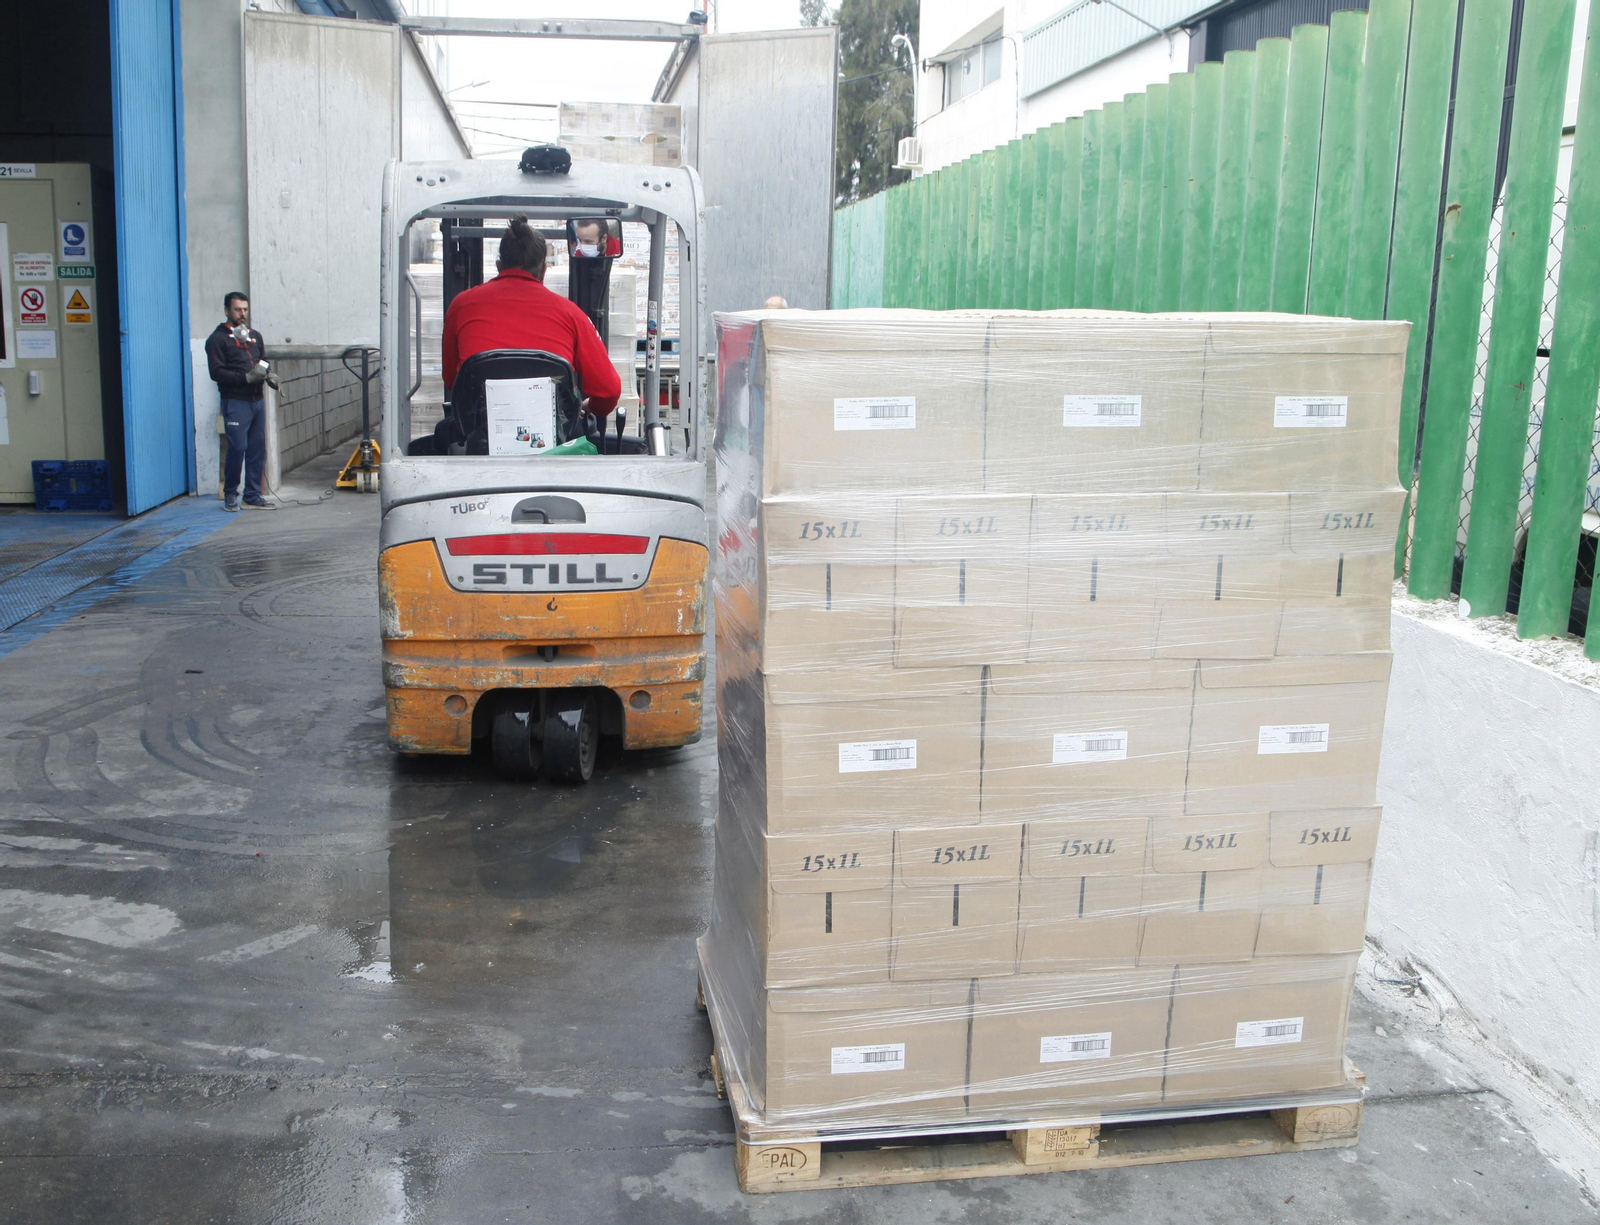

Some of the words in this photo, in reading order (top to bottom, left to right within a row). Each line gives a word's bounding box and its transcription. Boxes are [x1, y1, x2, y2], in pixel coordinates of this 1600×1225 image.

[60, 268, 92, 276] SALIDA
[798, 520, 862, 541] 15x1L
[936, 516, 998, 537] 15x1L
[1070, 513, 1130, 534] 15x1L
[1200, 513, 1256, 532] 15x1L
[1320, 512, 1375, 531] 15x1L
[473, 563, 622, 584] STILL
[1182, 832, 1238, 852] 15x1L
[1298, 826, 1352, 846] 15x1L
[932, 844, 991, 865] 15x1L
[1059, 838, 1116, 857] 15x1L
[801, 852, 861, 873] 15x1L
